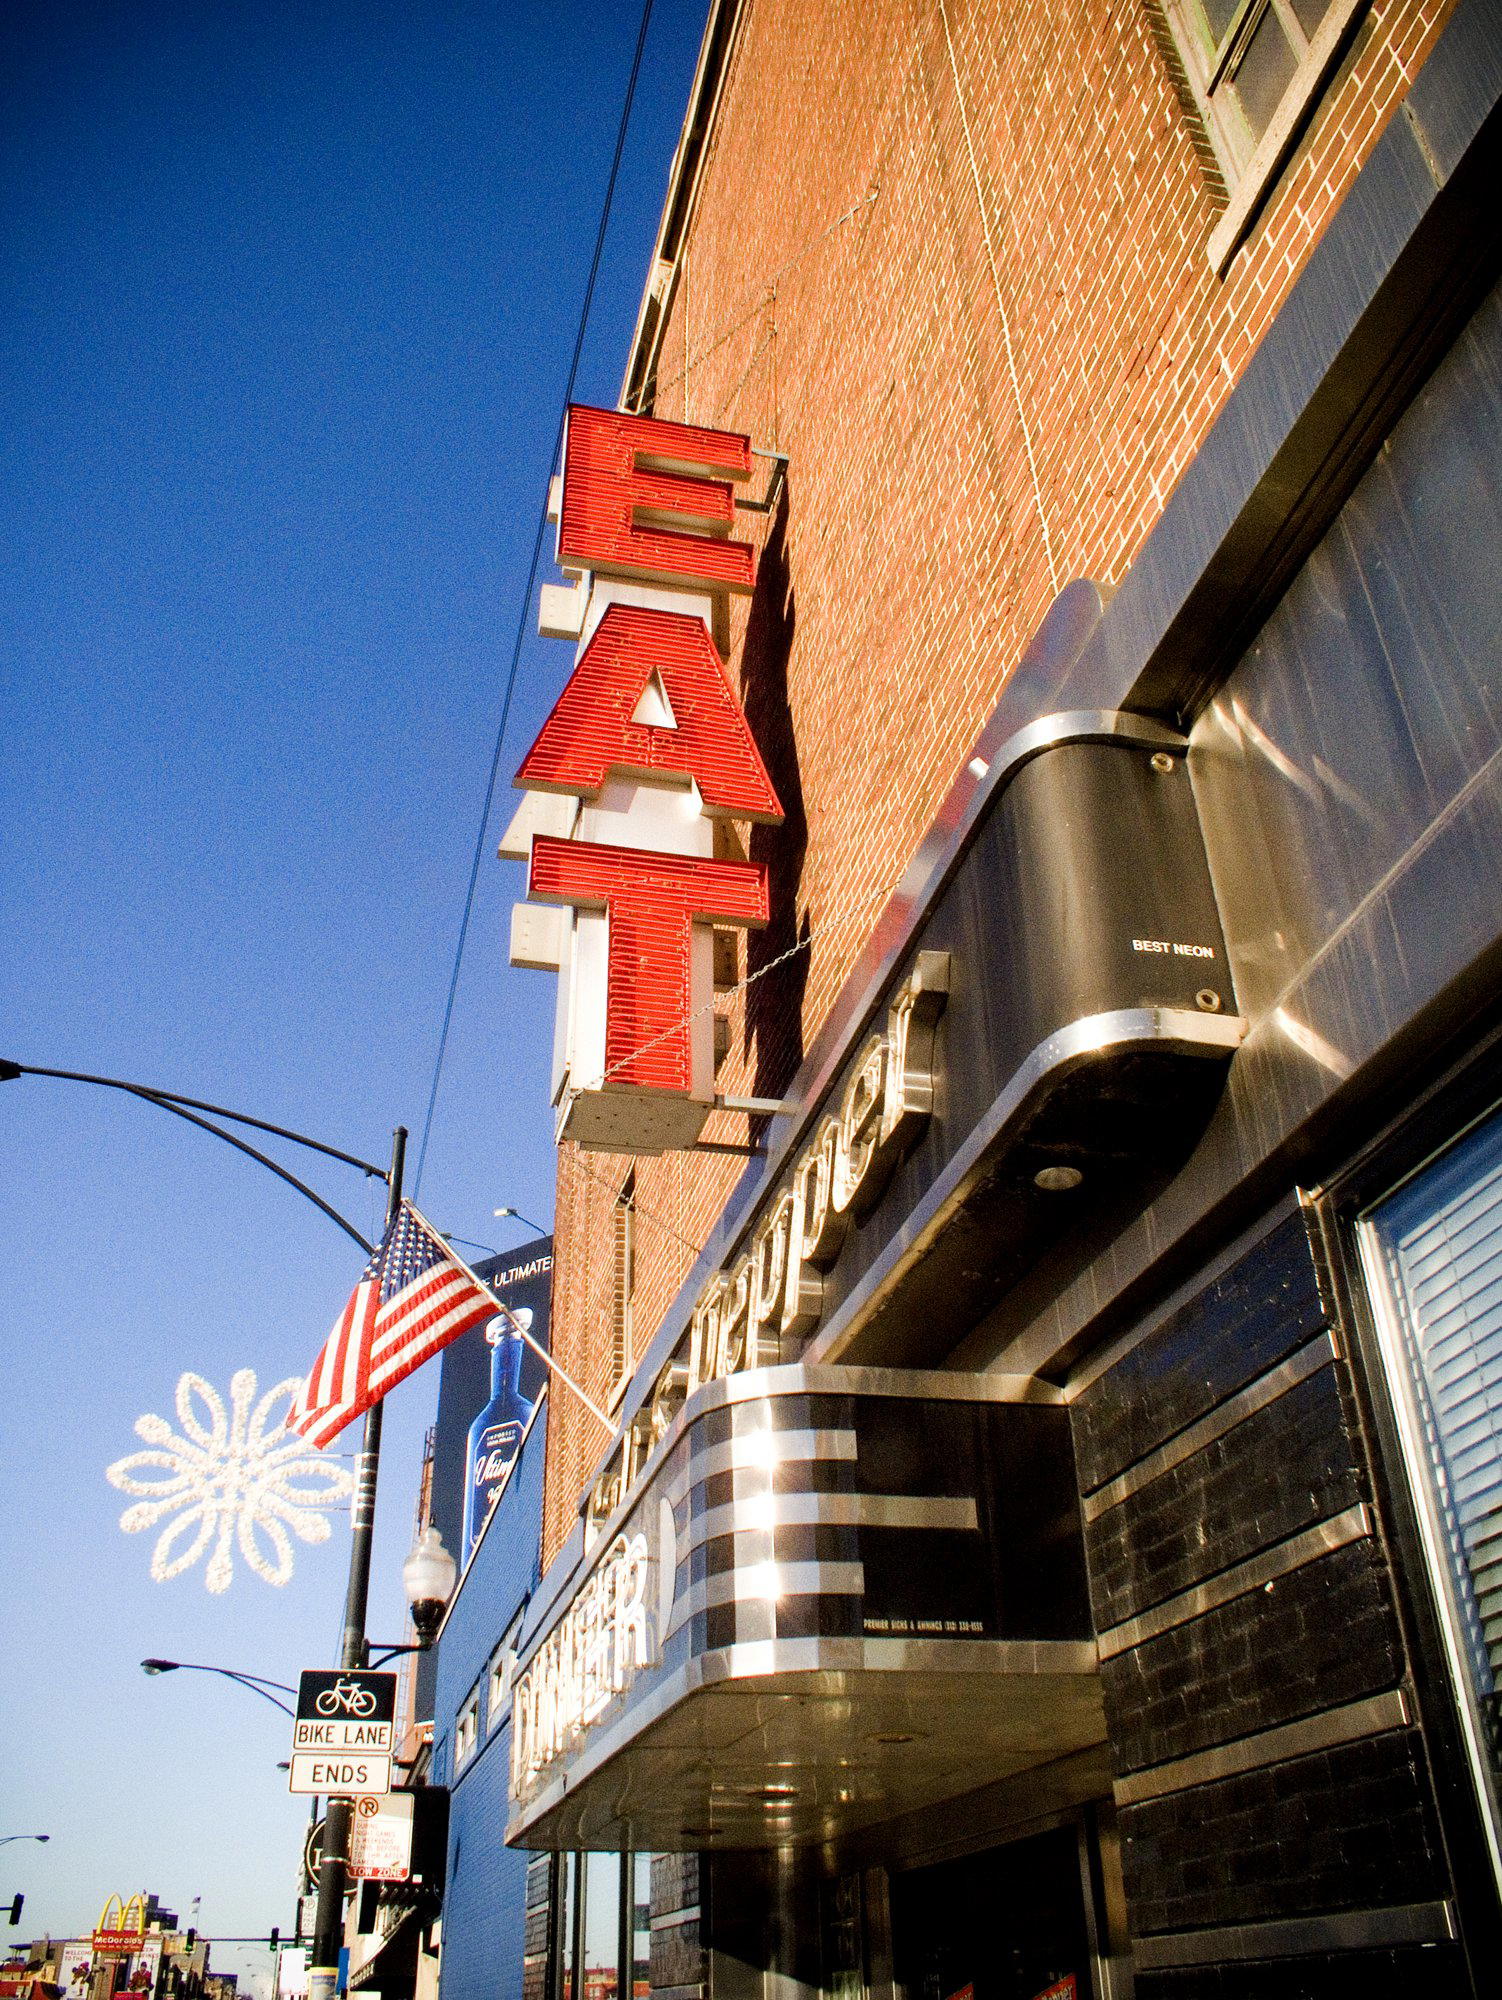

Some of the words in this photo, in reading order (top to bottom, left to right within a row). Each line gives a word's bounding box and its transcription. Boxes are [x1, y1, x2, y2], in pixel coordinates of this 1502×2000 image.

[512, 403, 785, 1094] EAT
[1132, 939, 1170, 953] BEST
[1173, 943, 1214, 958] NEON
[298, 1725, 335, 1743] BIKE
[344, 1726, 389, 1745] LANE
[312, 1765, 368, 1784] ENDS
[353, 1867, 373, 1877] TOW
[378, 1867, 403, 1878] ZONE
